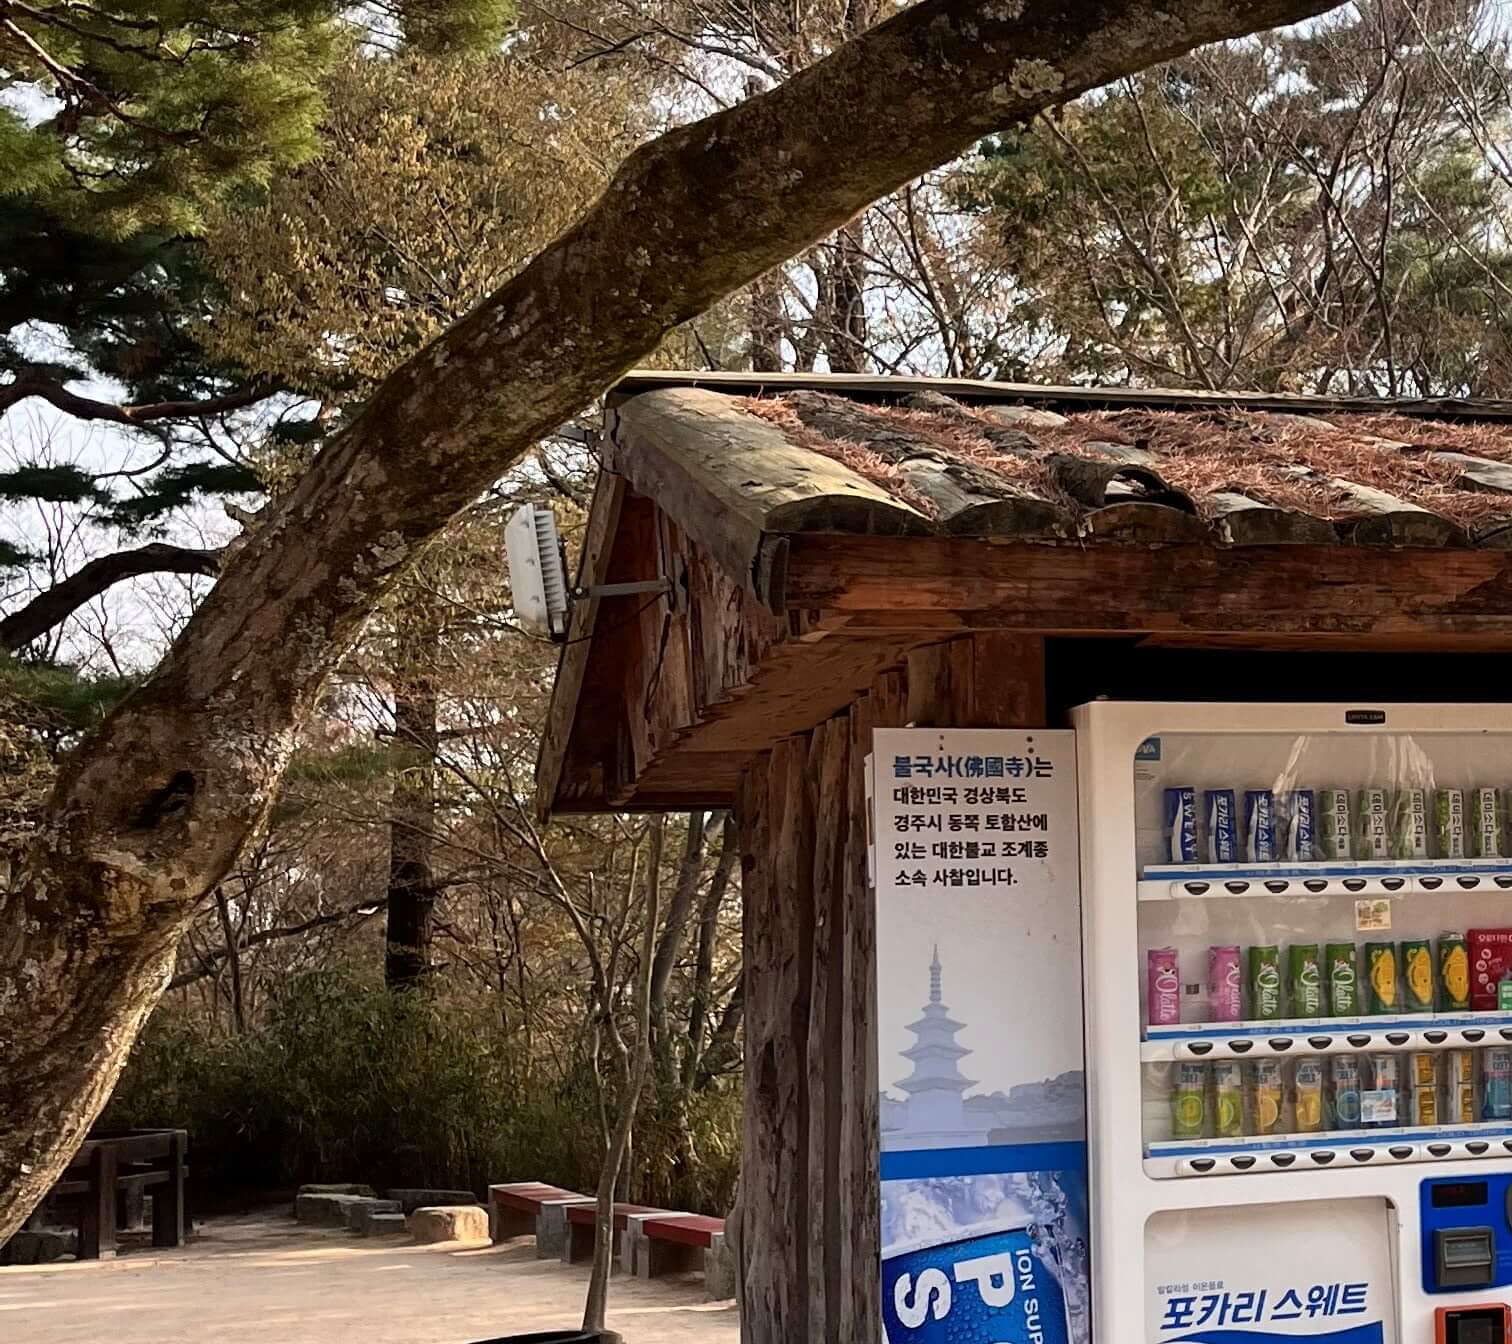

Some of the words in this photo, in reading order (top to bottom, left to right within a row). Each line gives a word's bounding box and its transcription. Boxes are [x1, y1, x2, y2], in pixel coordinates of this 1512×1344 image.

[893, 756, 1053, 778] 불국사(佛國寺)는
[893, 786, 958, 805] 대한민국
[963, 786, 1027, 805] 경상북도
[894, 814, 942, 833] 경주시
[948, 814, 980, 833] 동쪽
[984, 813, 1048, 832] 토함산에
[1335, 794, 1348, 836] 데미소다
[1371, 794, 1384, 836] 데미소다
[1482, 792, 1495, 834] 데미소다
[894, 842, 927, 860] 있는
[932, 841, 996, 859] 대한불교
[1002, 841, 1048, 859] 조계종
[895, 869, 927, 887] 소속
[932, 868, 1018, 887] 사찰입니다.
[1016, 1249, 1034, 1289] ION
